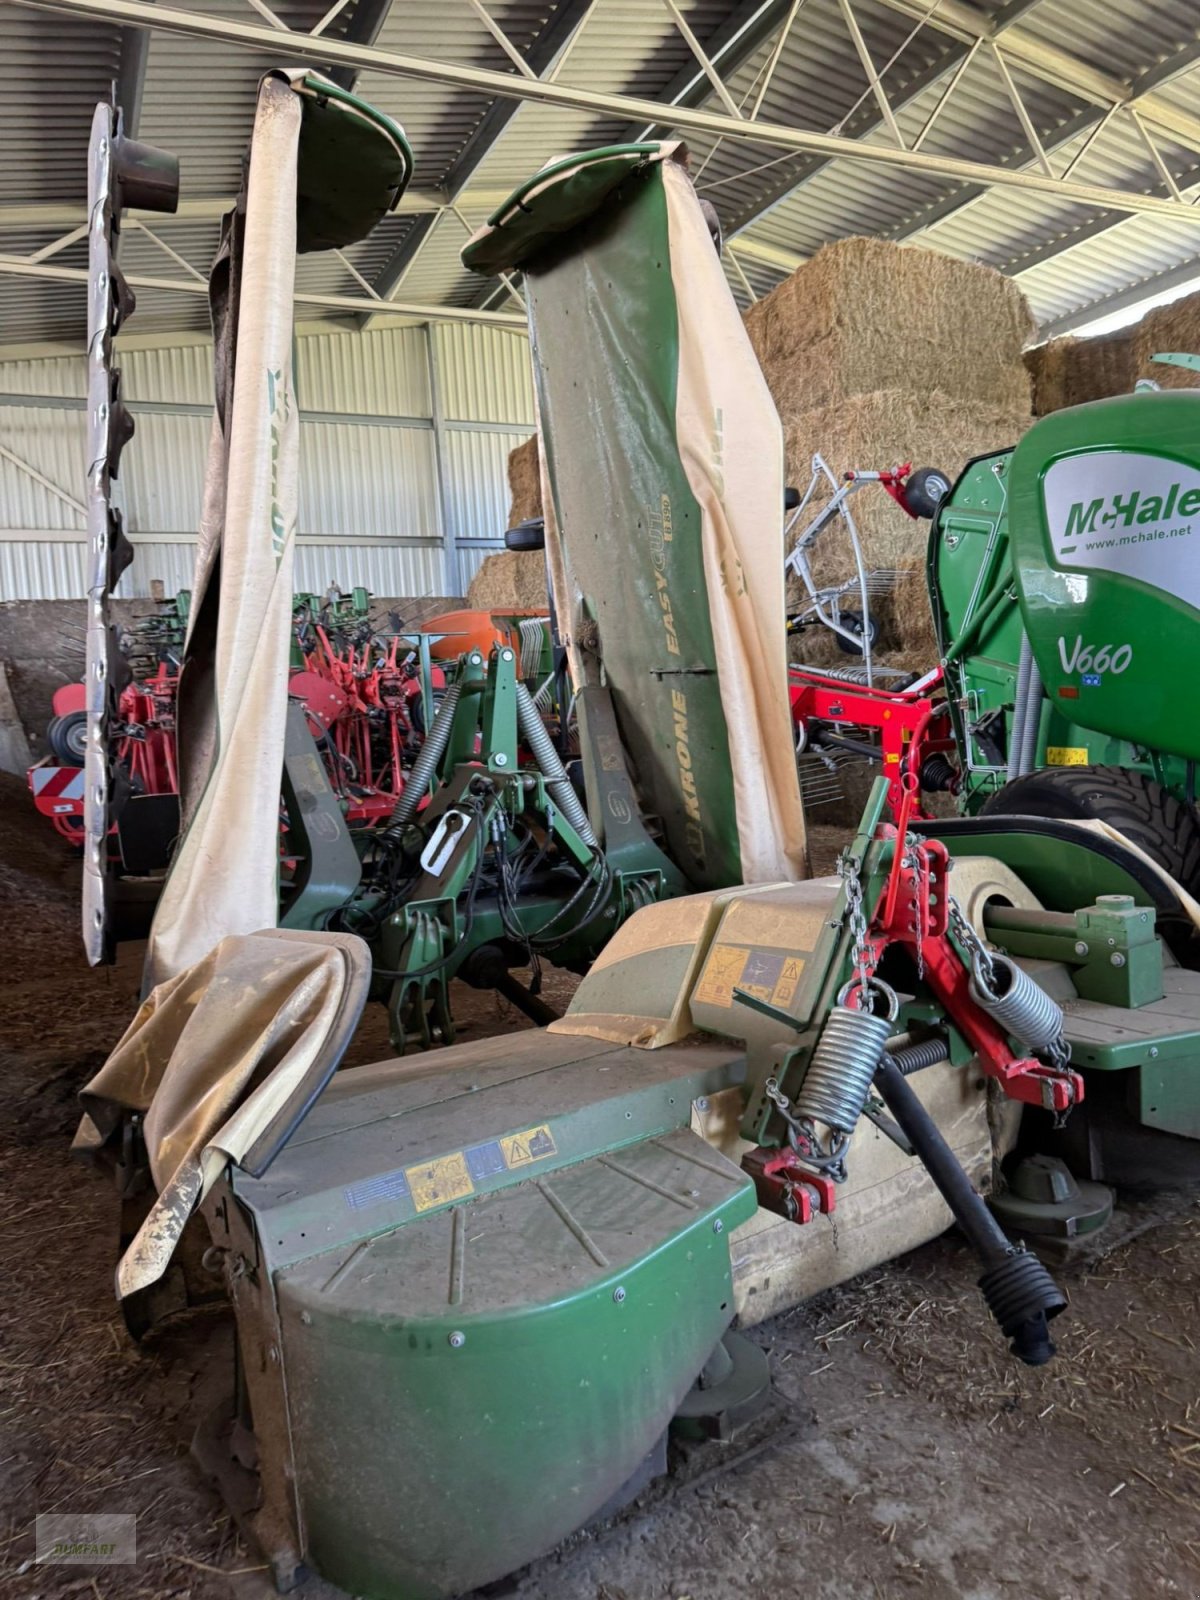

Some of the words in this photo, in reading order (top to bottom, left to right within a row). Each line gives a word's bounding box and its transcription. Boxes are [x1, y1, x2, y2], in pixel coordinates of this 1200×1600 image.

[1065, 483, 1200, 537] McHale
[1086, 526, 1192, 551] www.mchale.net
[1058, 634, 1133, 674] V660
[672, 689, 702, 820] KRONE
